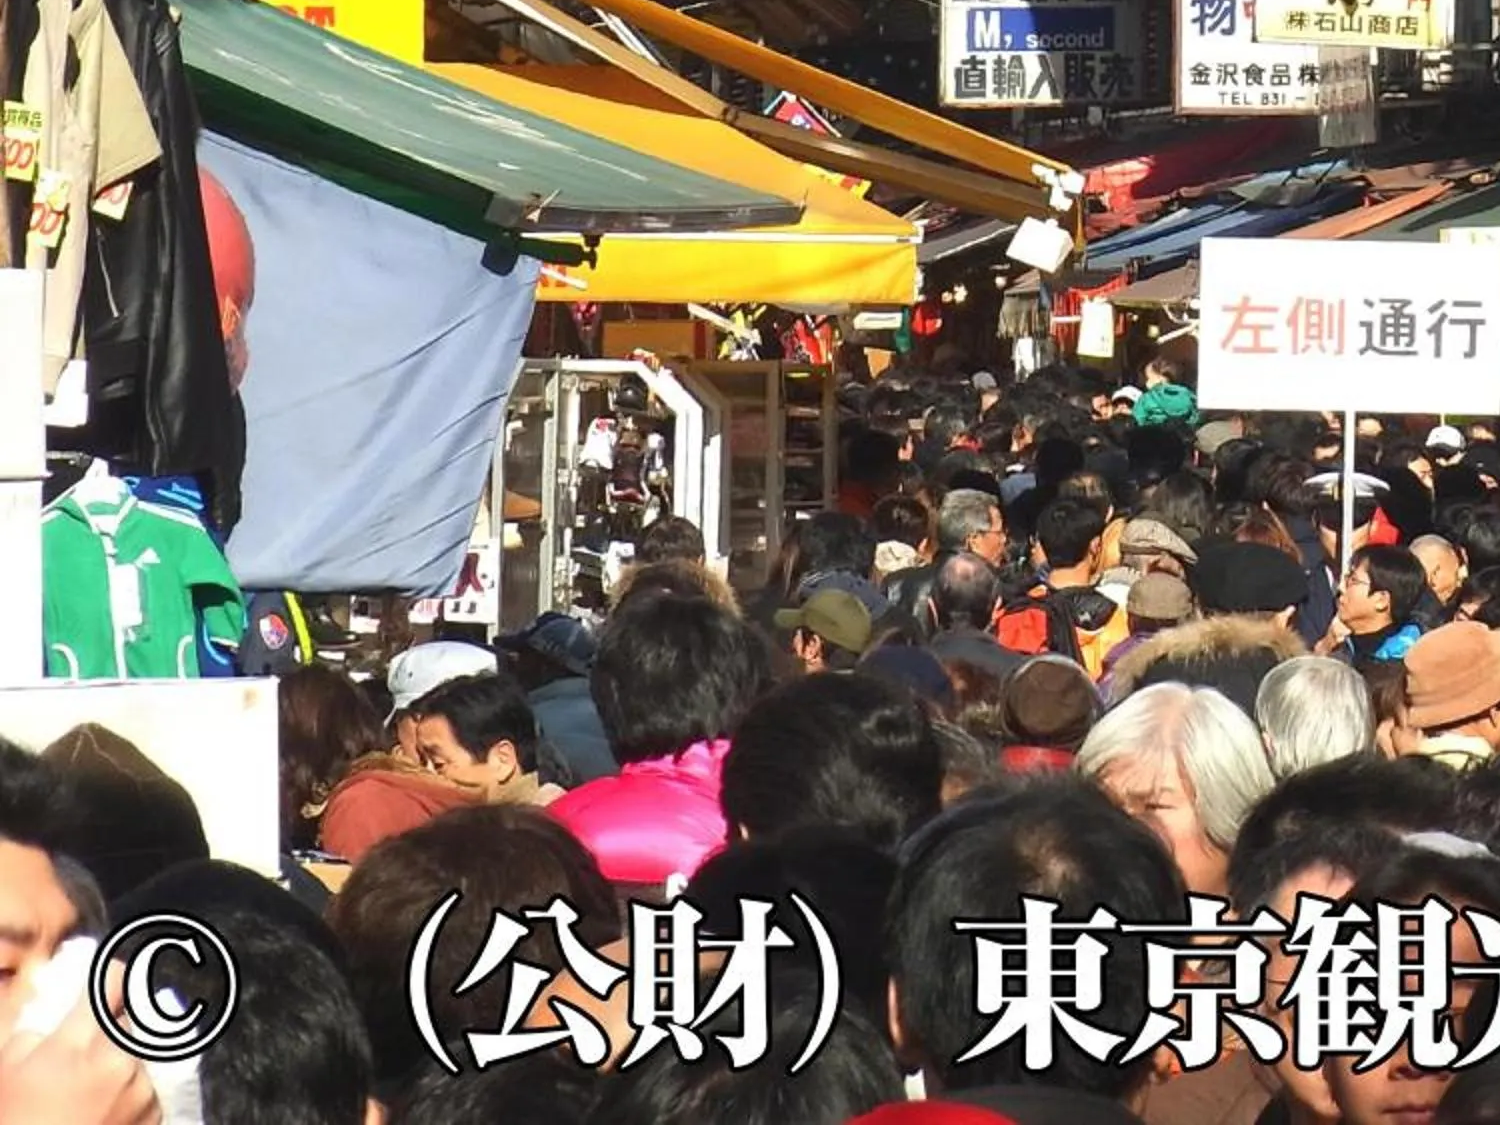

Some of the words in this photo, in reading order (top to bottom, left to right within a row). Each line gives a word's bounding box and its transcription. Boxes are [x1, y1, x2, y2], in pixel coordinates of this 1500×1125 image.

[954, 54, 1134, 99] 直輸入販売
[1218, 92, 1253, 105] TEL
[1220, 295, 1487, 359] 左側通行
